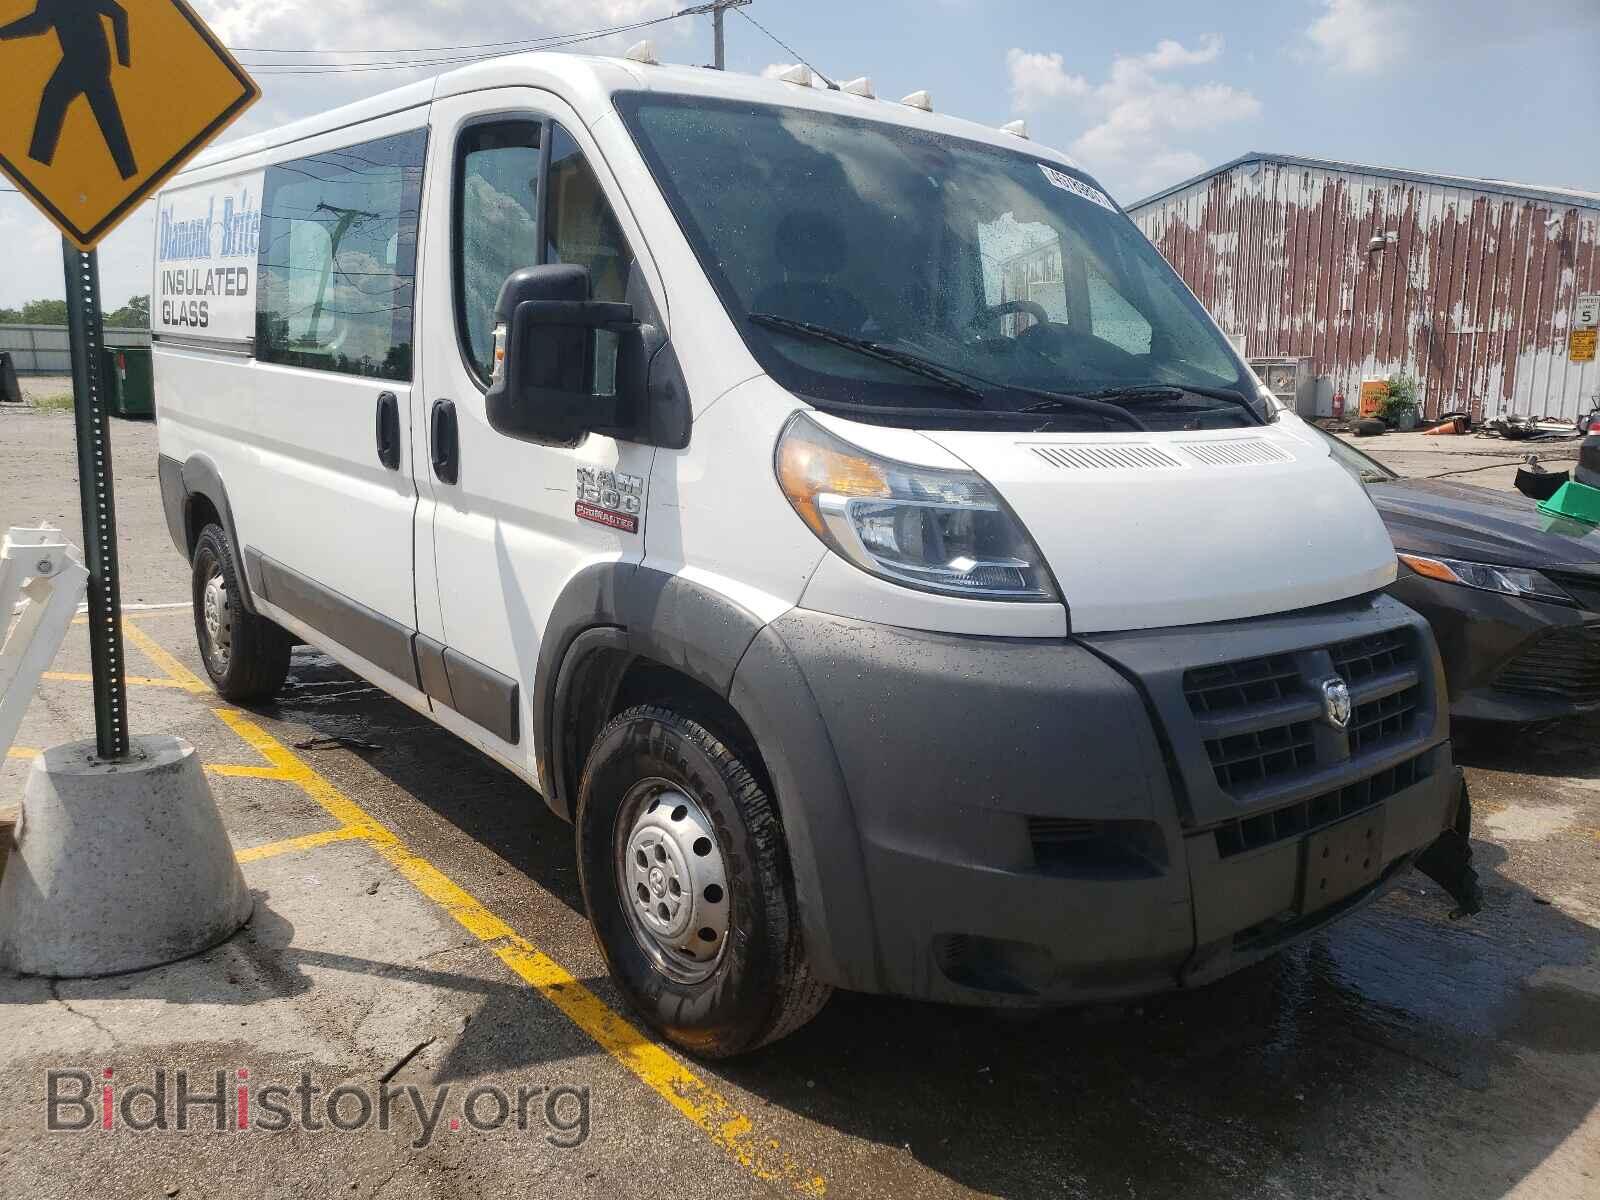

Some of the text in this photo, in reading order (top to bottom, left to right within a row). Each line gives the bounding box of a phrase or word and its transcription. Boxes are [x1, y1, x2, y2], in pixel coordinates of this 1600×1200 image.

[160, 185, 260, 261] Diamond Brite
[162, 266, 249, 296] INSULATED
[162, 300, 209, 328] GLASS
[1582, 311, 1592, 322] 5
